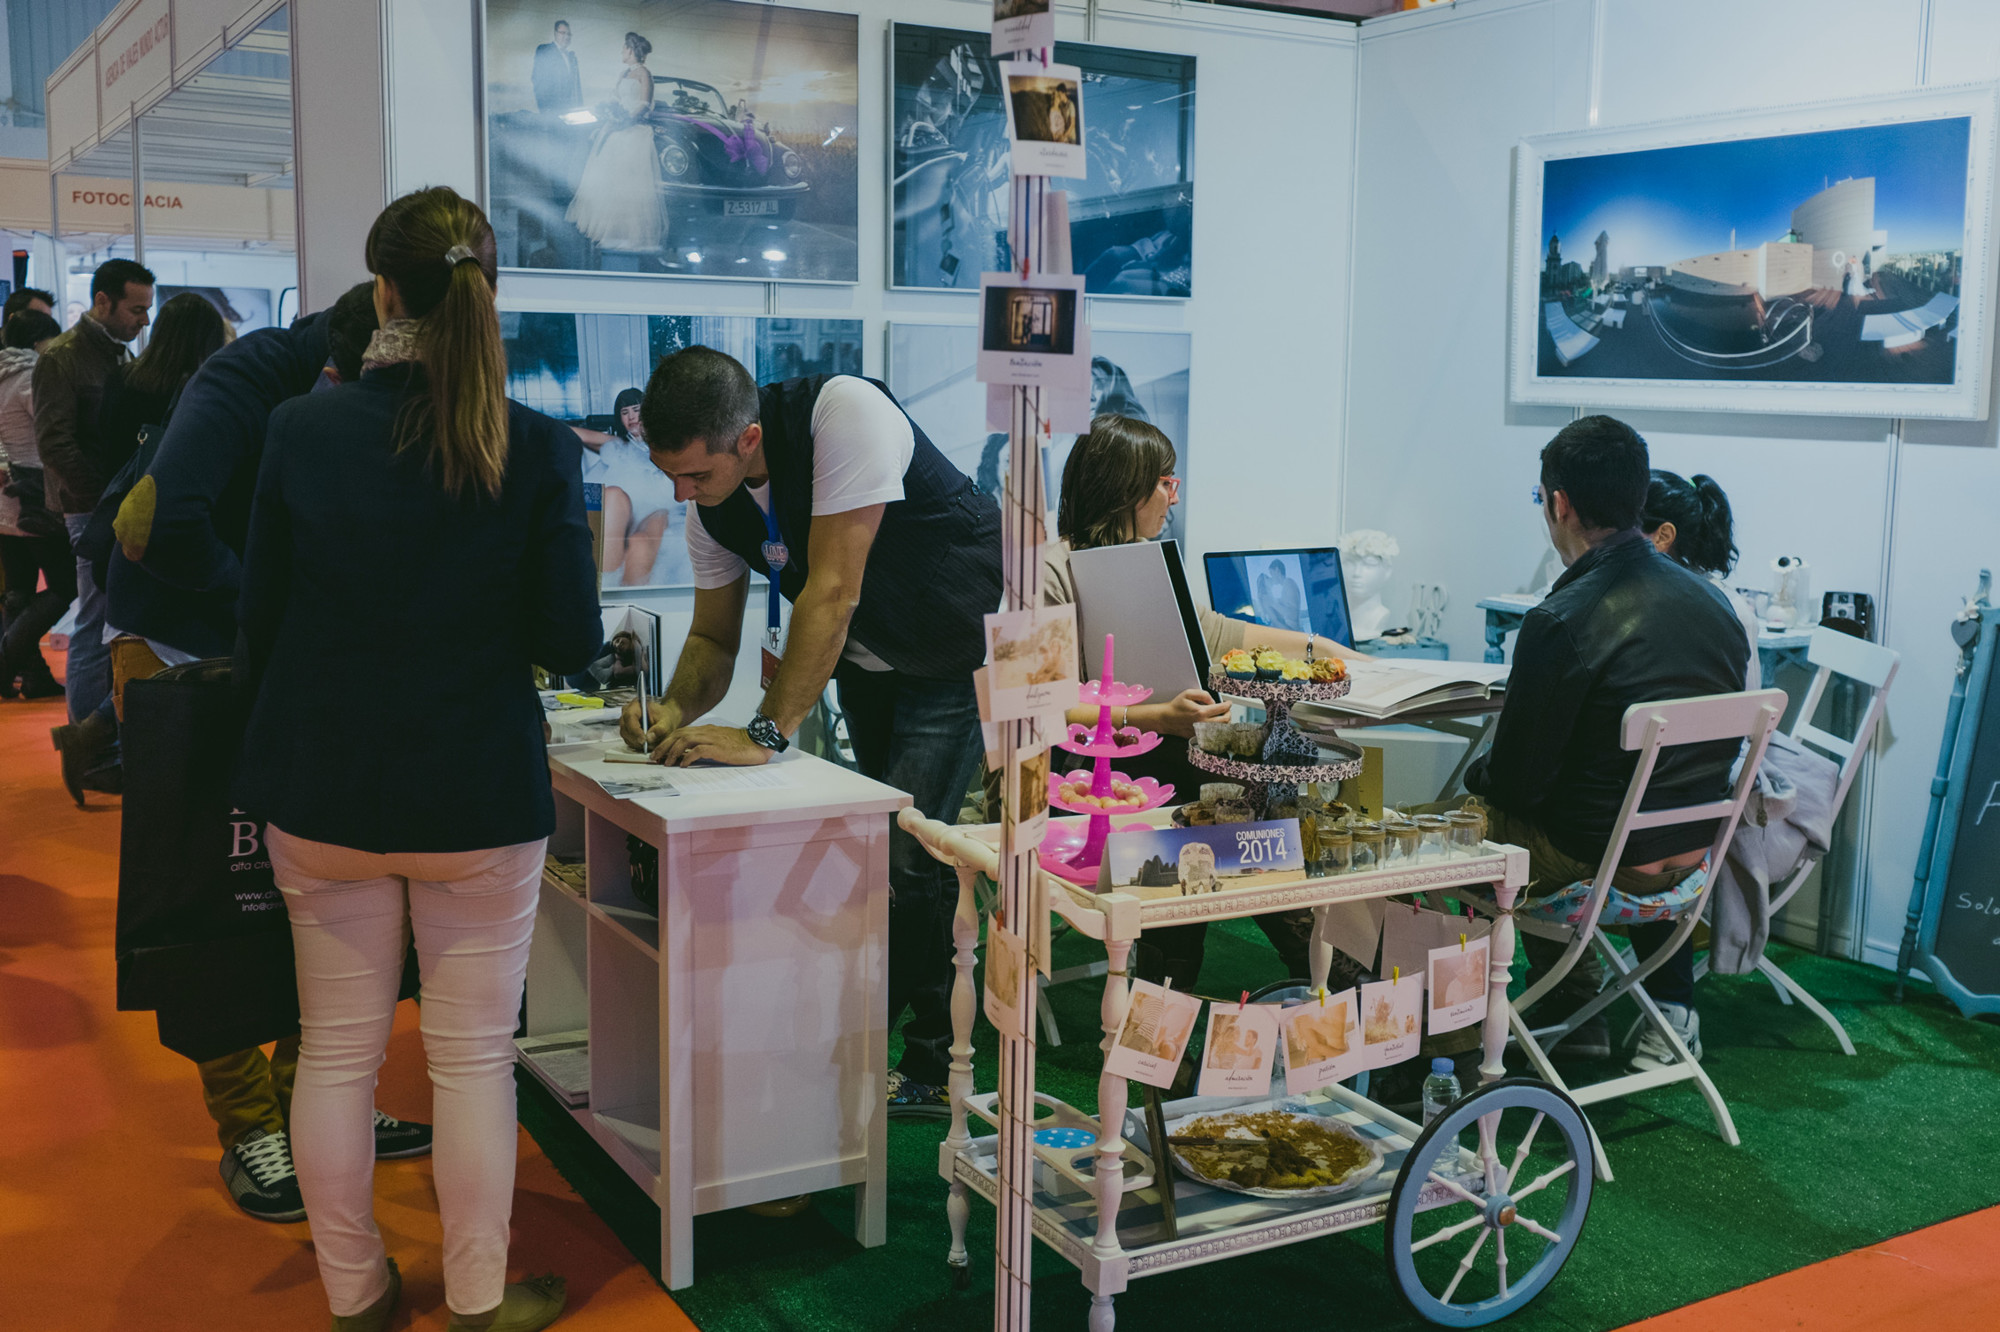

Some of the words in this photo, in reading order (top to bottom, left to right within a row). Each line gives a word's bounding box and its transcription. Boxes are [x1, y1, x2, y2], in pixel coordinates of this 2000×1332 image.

[72, 190, 183, 209] FOTOCACIA
[1235, 827, 1285, 842] COMUNIONES
[1237, 838, 1287, 864] 2014
[230, 861, 252, 872] alta
